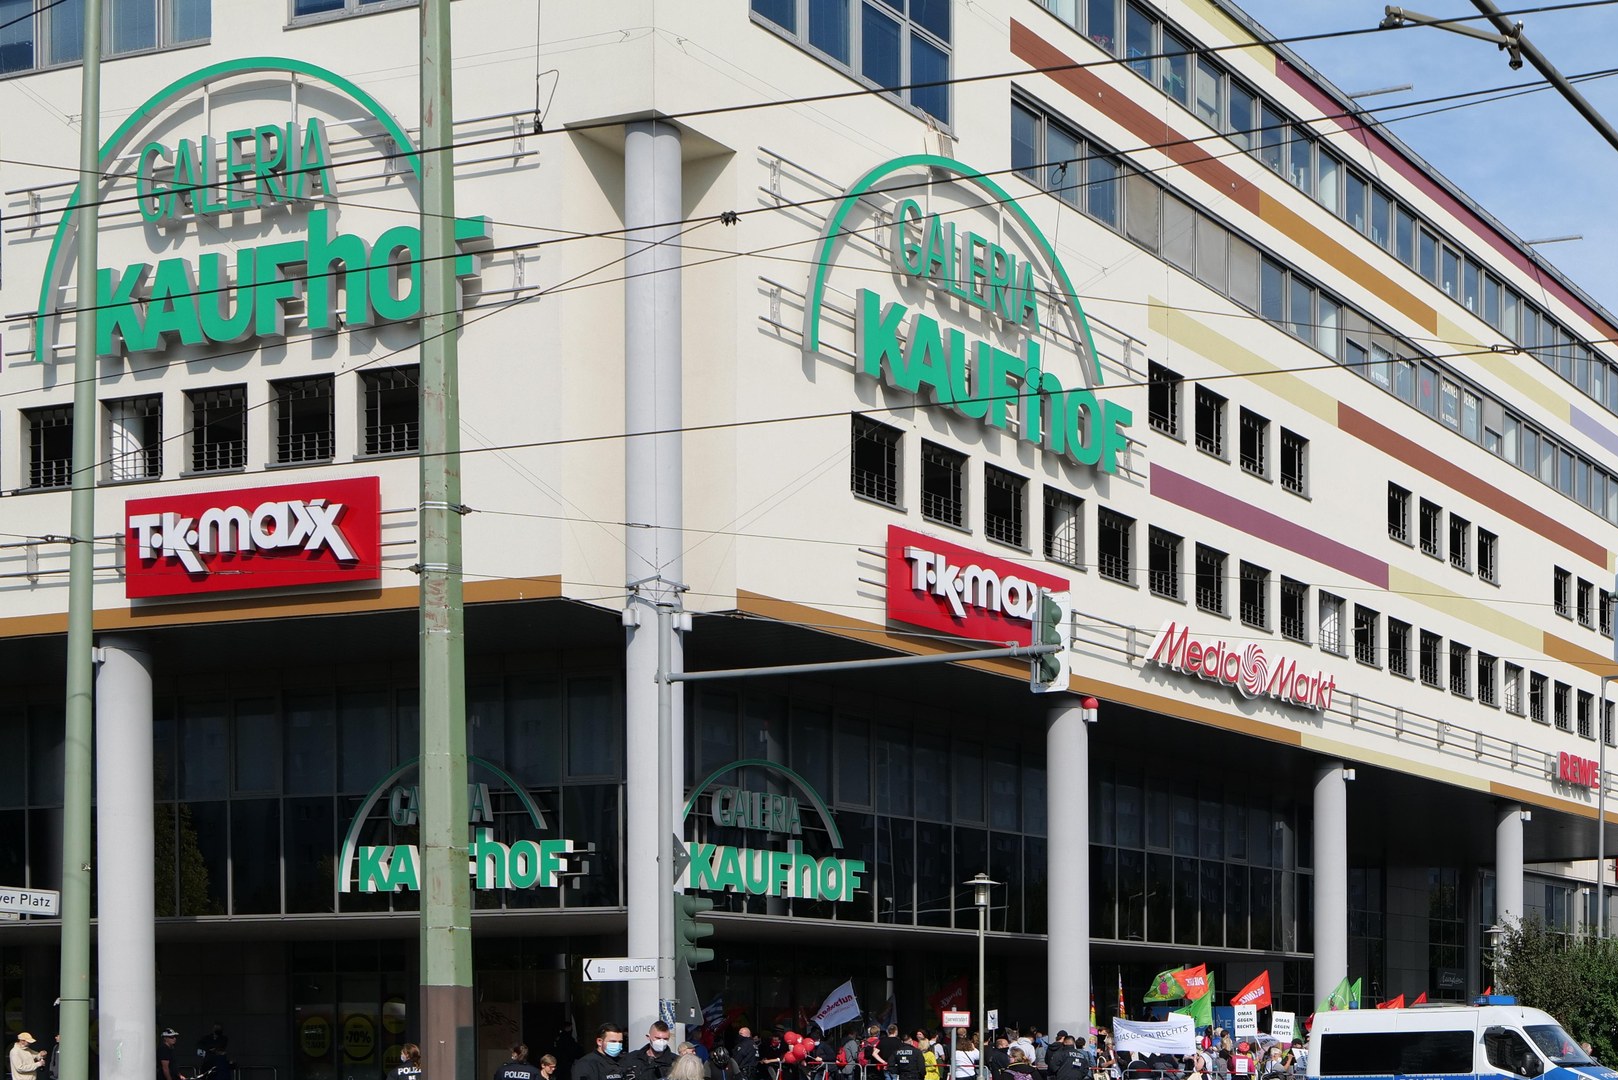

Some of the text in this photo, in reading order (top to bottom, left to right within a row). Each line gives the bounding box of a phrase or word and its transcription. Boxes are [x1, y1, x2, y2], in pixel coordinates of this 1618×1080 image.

[136, 117, 336, 223] GALERIA
[894, 199, 1040, 333] GALERIA
[1147, 621, 1336, 710] Media Markt
[1558, 751, 1600, 789] REWE
[714, 786, 802, 834] GALERIA
[359, 827, 570, 892] KAhoF
[20, 893, 51, 907] Platz
[618, 965, 656, 973] BIBLIOTHEK
[1155, 1025, 1189, 1039] RECHTS
[504, 1070, 531, 1079] POLIZEI
